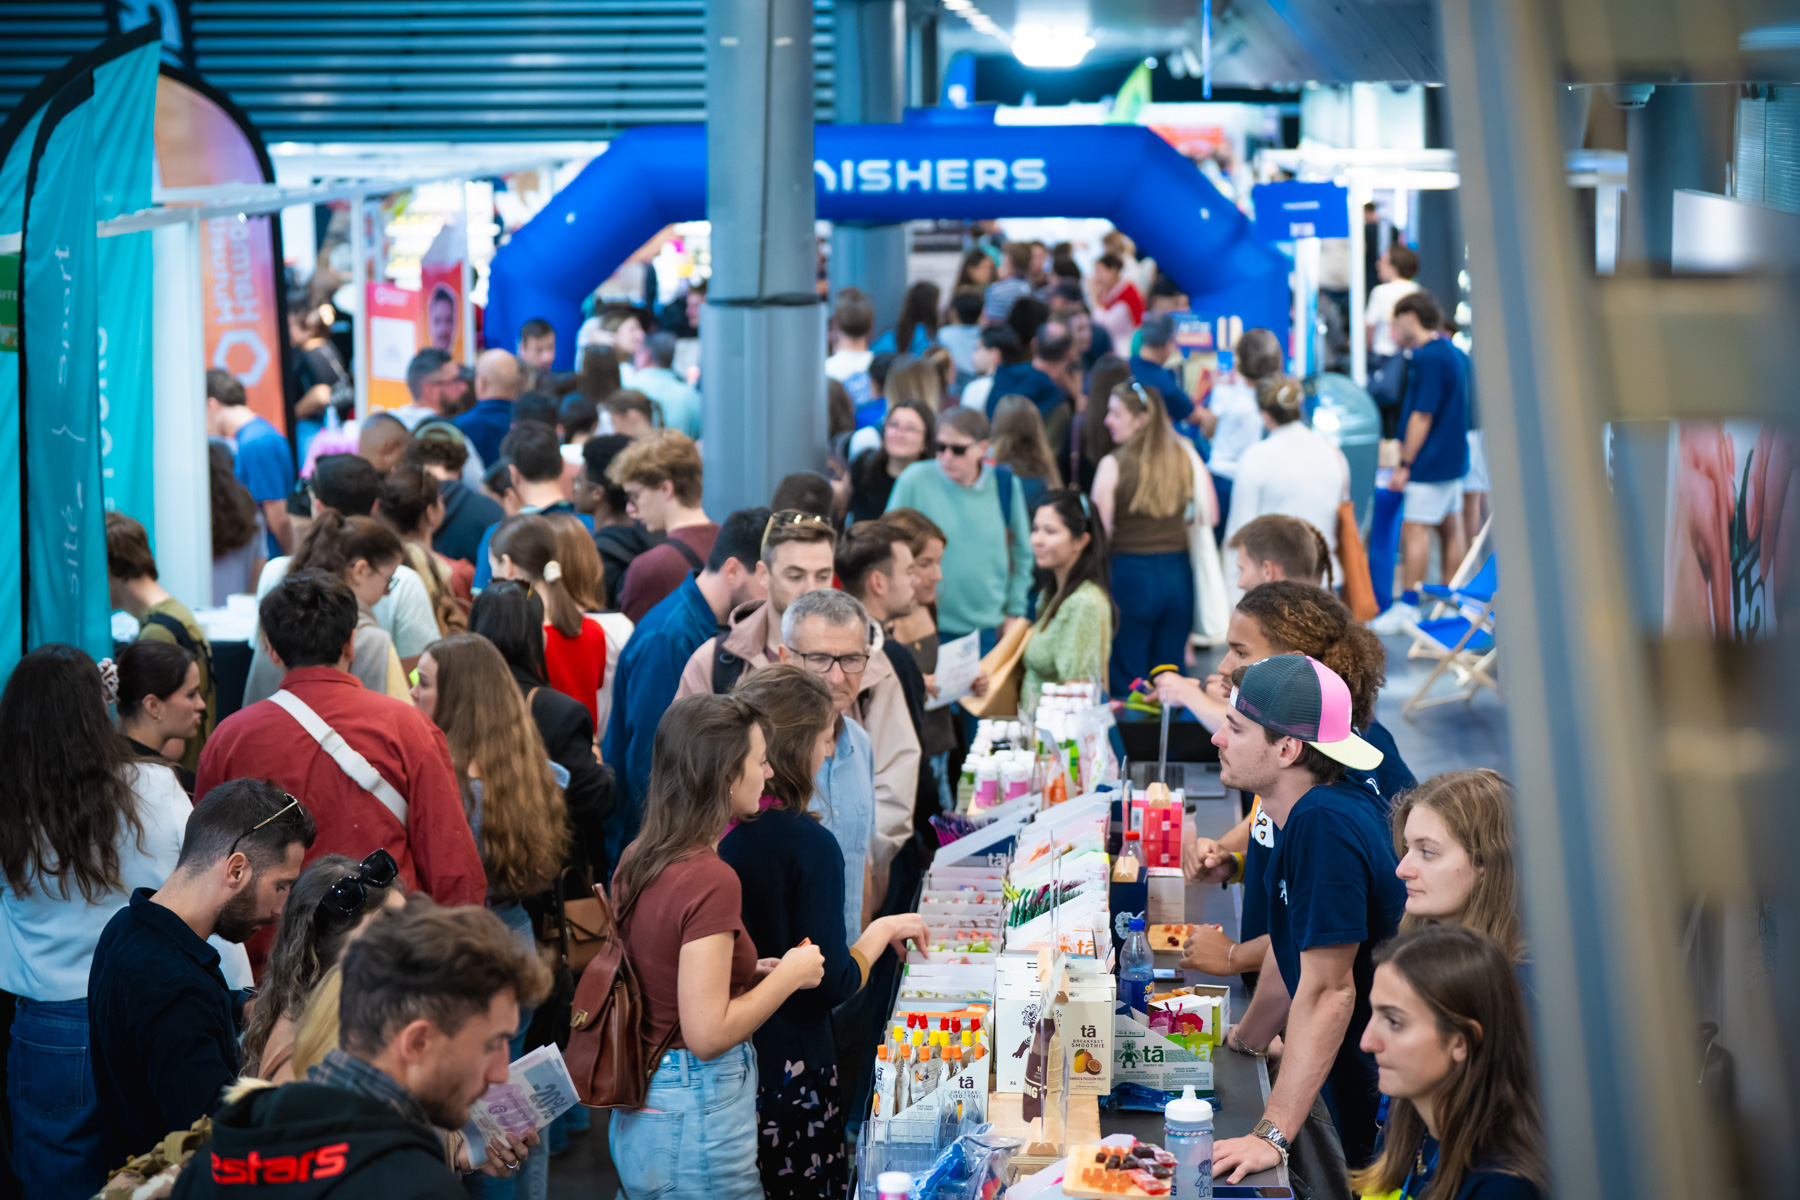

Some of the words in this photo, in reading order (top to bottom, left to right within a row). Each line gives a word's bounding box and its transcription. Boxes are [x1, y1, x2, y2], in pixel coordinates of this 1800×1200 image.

[1080, 1024, 1097, 1038] tā
[1142, 1045, 1164, 1063] tā
[958, 1076, 974, 1089] tā
[528, 1084, 570, 1120] -20%
